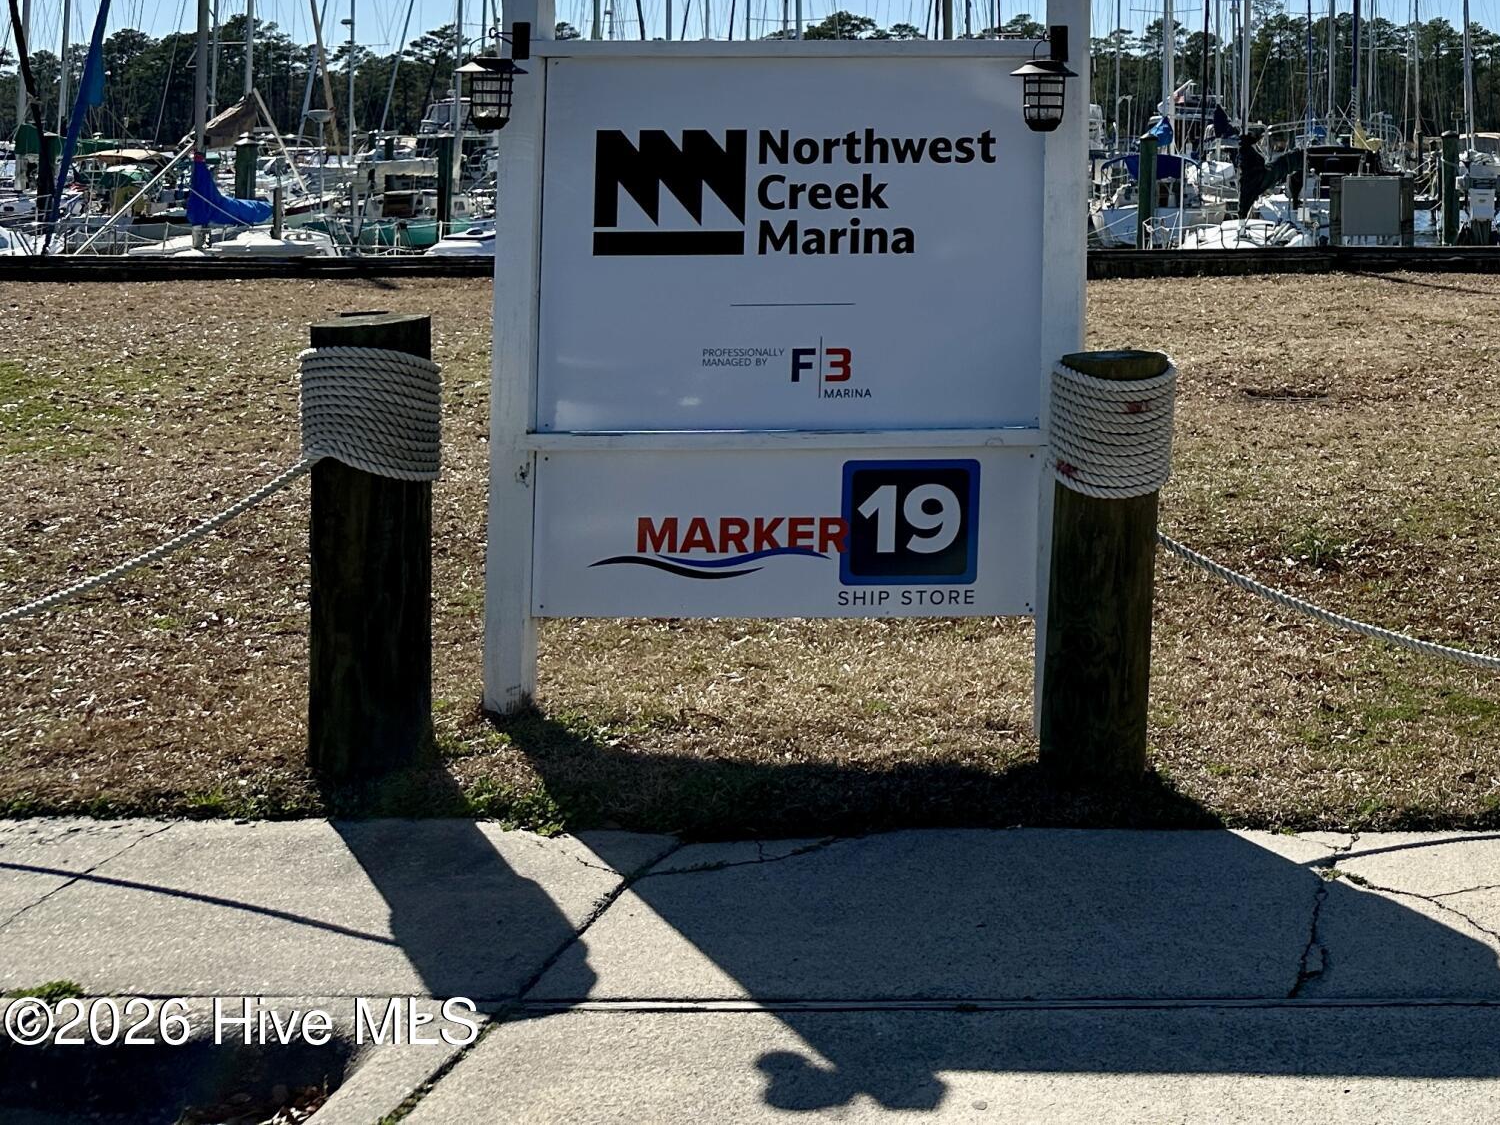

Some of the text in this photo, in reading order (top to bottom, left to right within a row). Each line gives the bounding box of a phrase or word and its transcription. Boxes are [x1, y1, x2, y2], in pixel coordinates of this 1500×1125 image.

[758, 127, 997, 165] Northwest
[757, 172, 889, 211] Creek
[757, 217, 915, 256] Marina
[702, 347, 785, 358] PROFESSIONALLY
[702, 357, 768, 367] MANAGED BY
[823, 388, 872, 399] MARINA
[636, 484, 961, 554] MARKER 19
[838, 590, 975, 606] SHIP STORE
